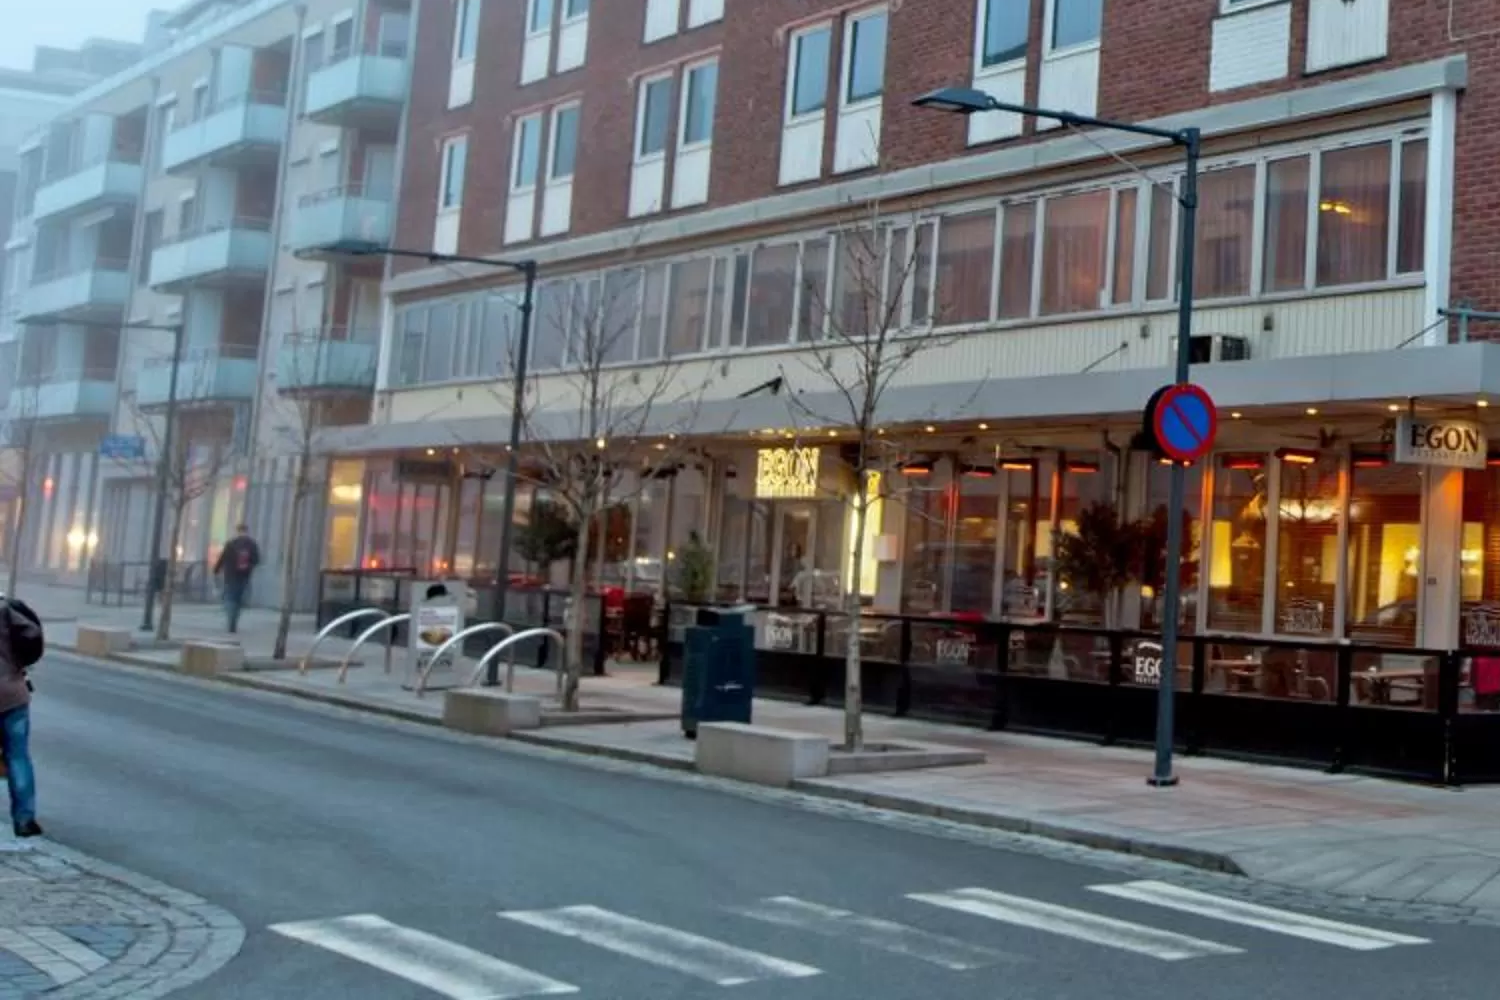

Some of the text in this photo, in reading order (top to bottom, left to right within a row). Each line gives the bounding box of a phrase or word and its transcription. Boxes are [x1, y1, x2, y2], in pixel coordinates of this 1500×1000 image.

[1411, 424, 1479, 453] EGON
[757, 447, 820, 481] EGON
[1135, 656, 1162, 677] EG
